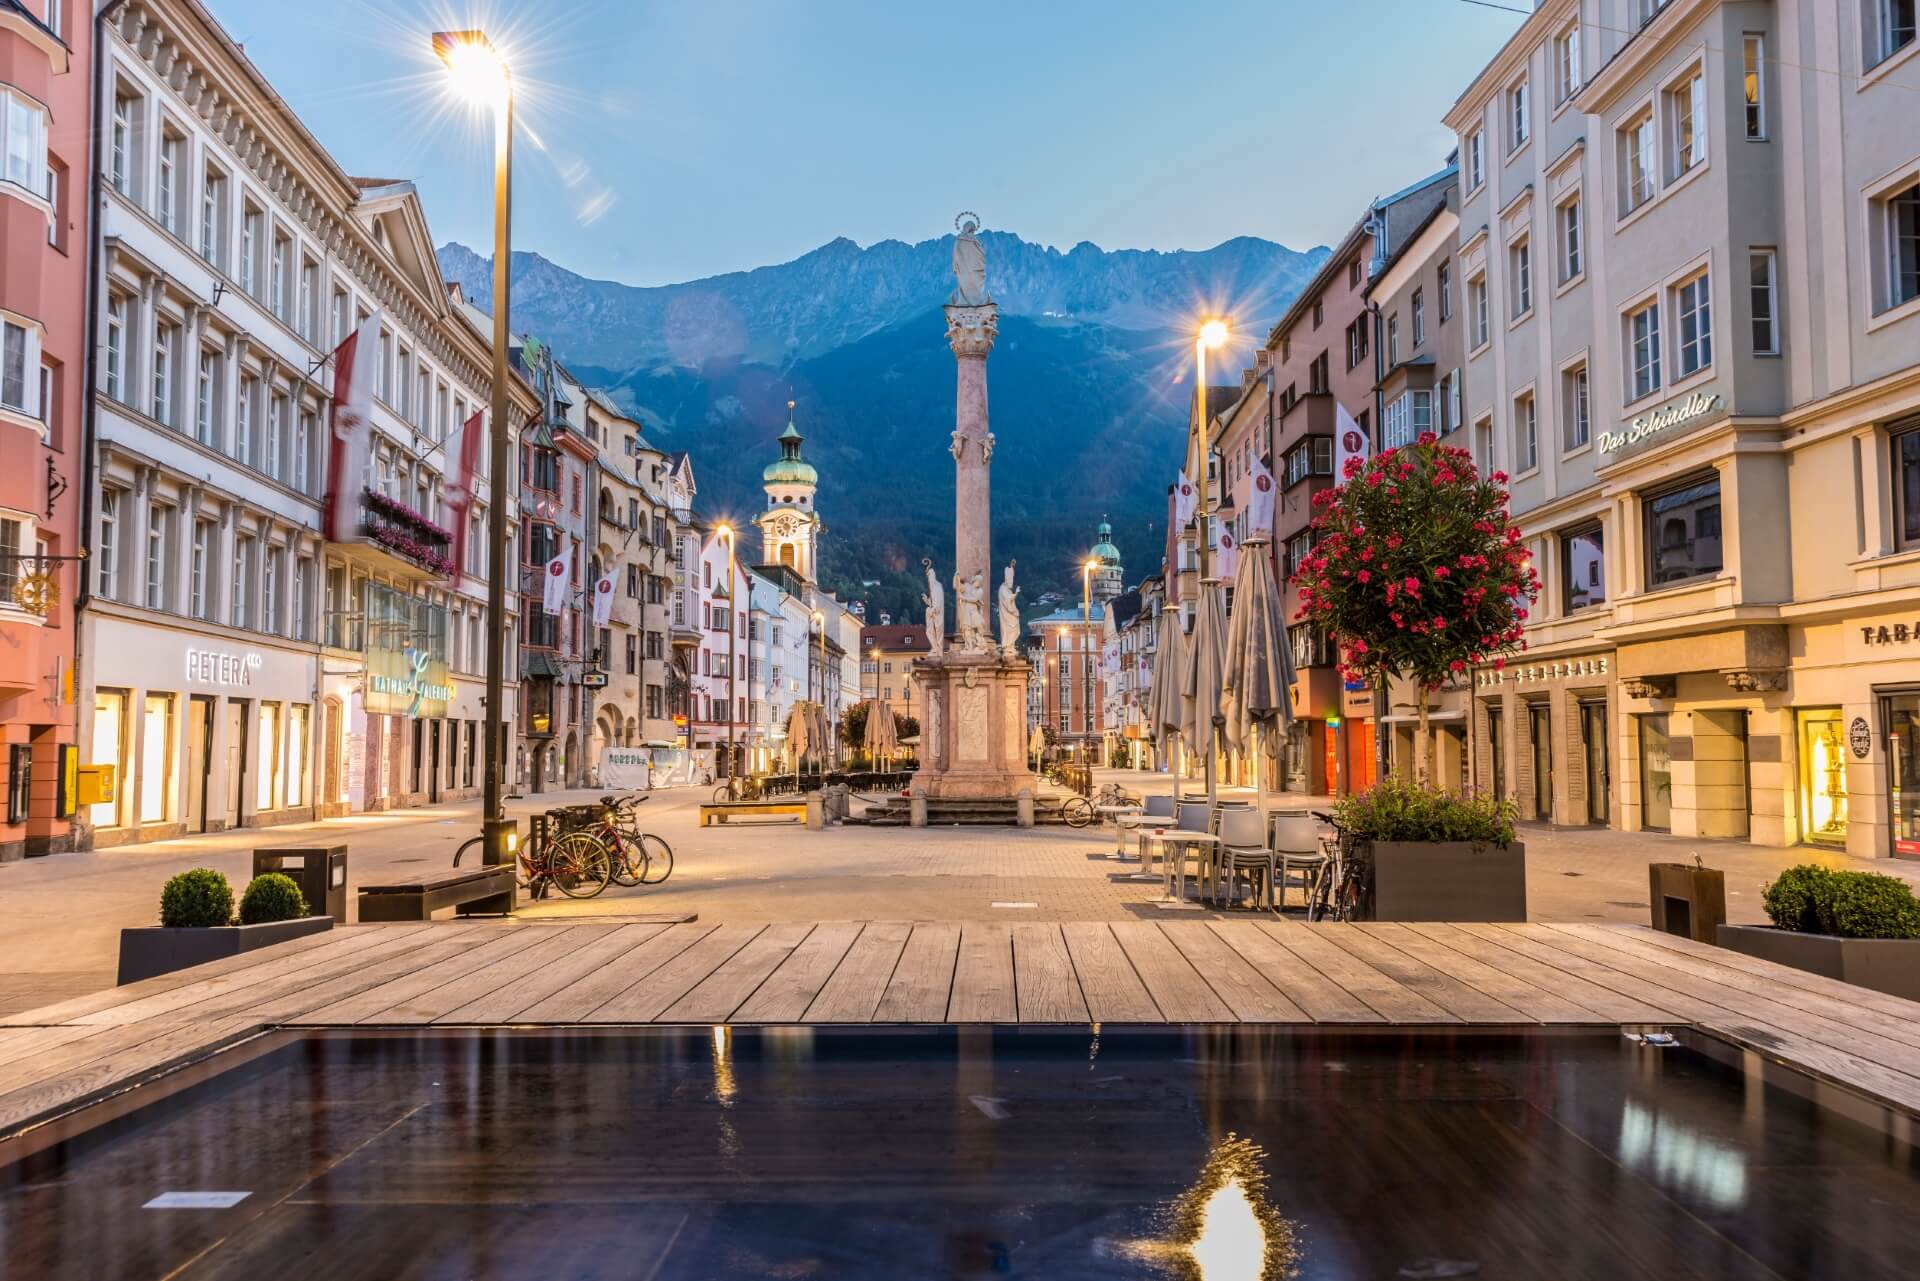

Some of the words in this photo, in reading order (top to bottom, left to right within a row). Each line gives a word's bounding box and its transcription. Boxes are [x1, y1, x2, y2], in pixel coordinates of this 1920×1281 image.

[1597, 431, 1627, 454] Das
[1628, 393, 1719, 443] Schindler
[186, 648, 250, 686] PETERA
[1479, 670, 1504, 688] BAR
[1514, 657, 1608, 685] CENTRALE
